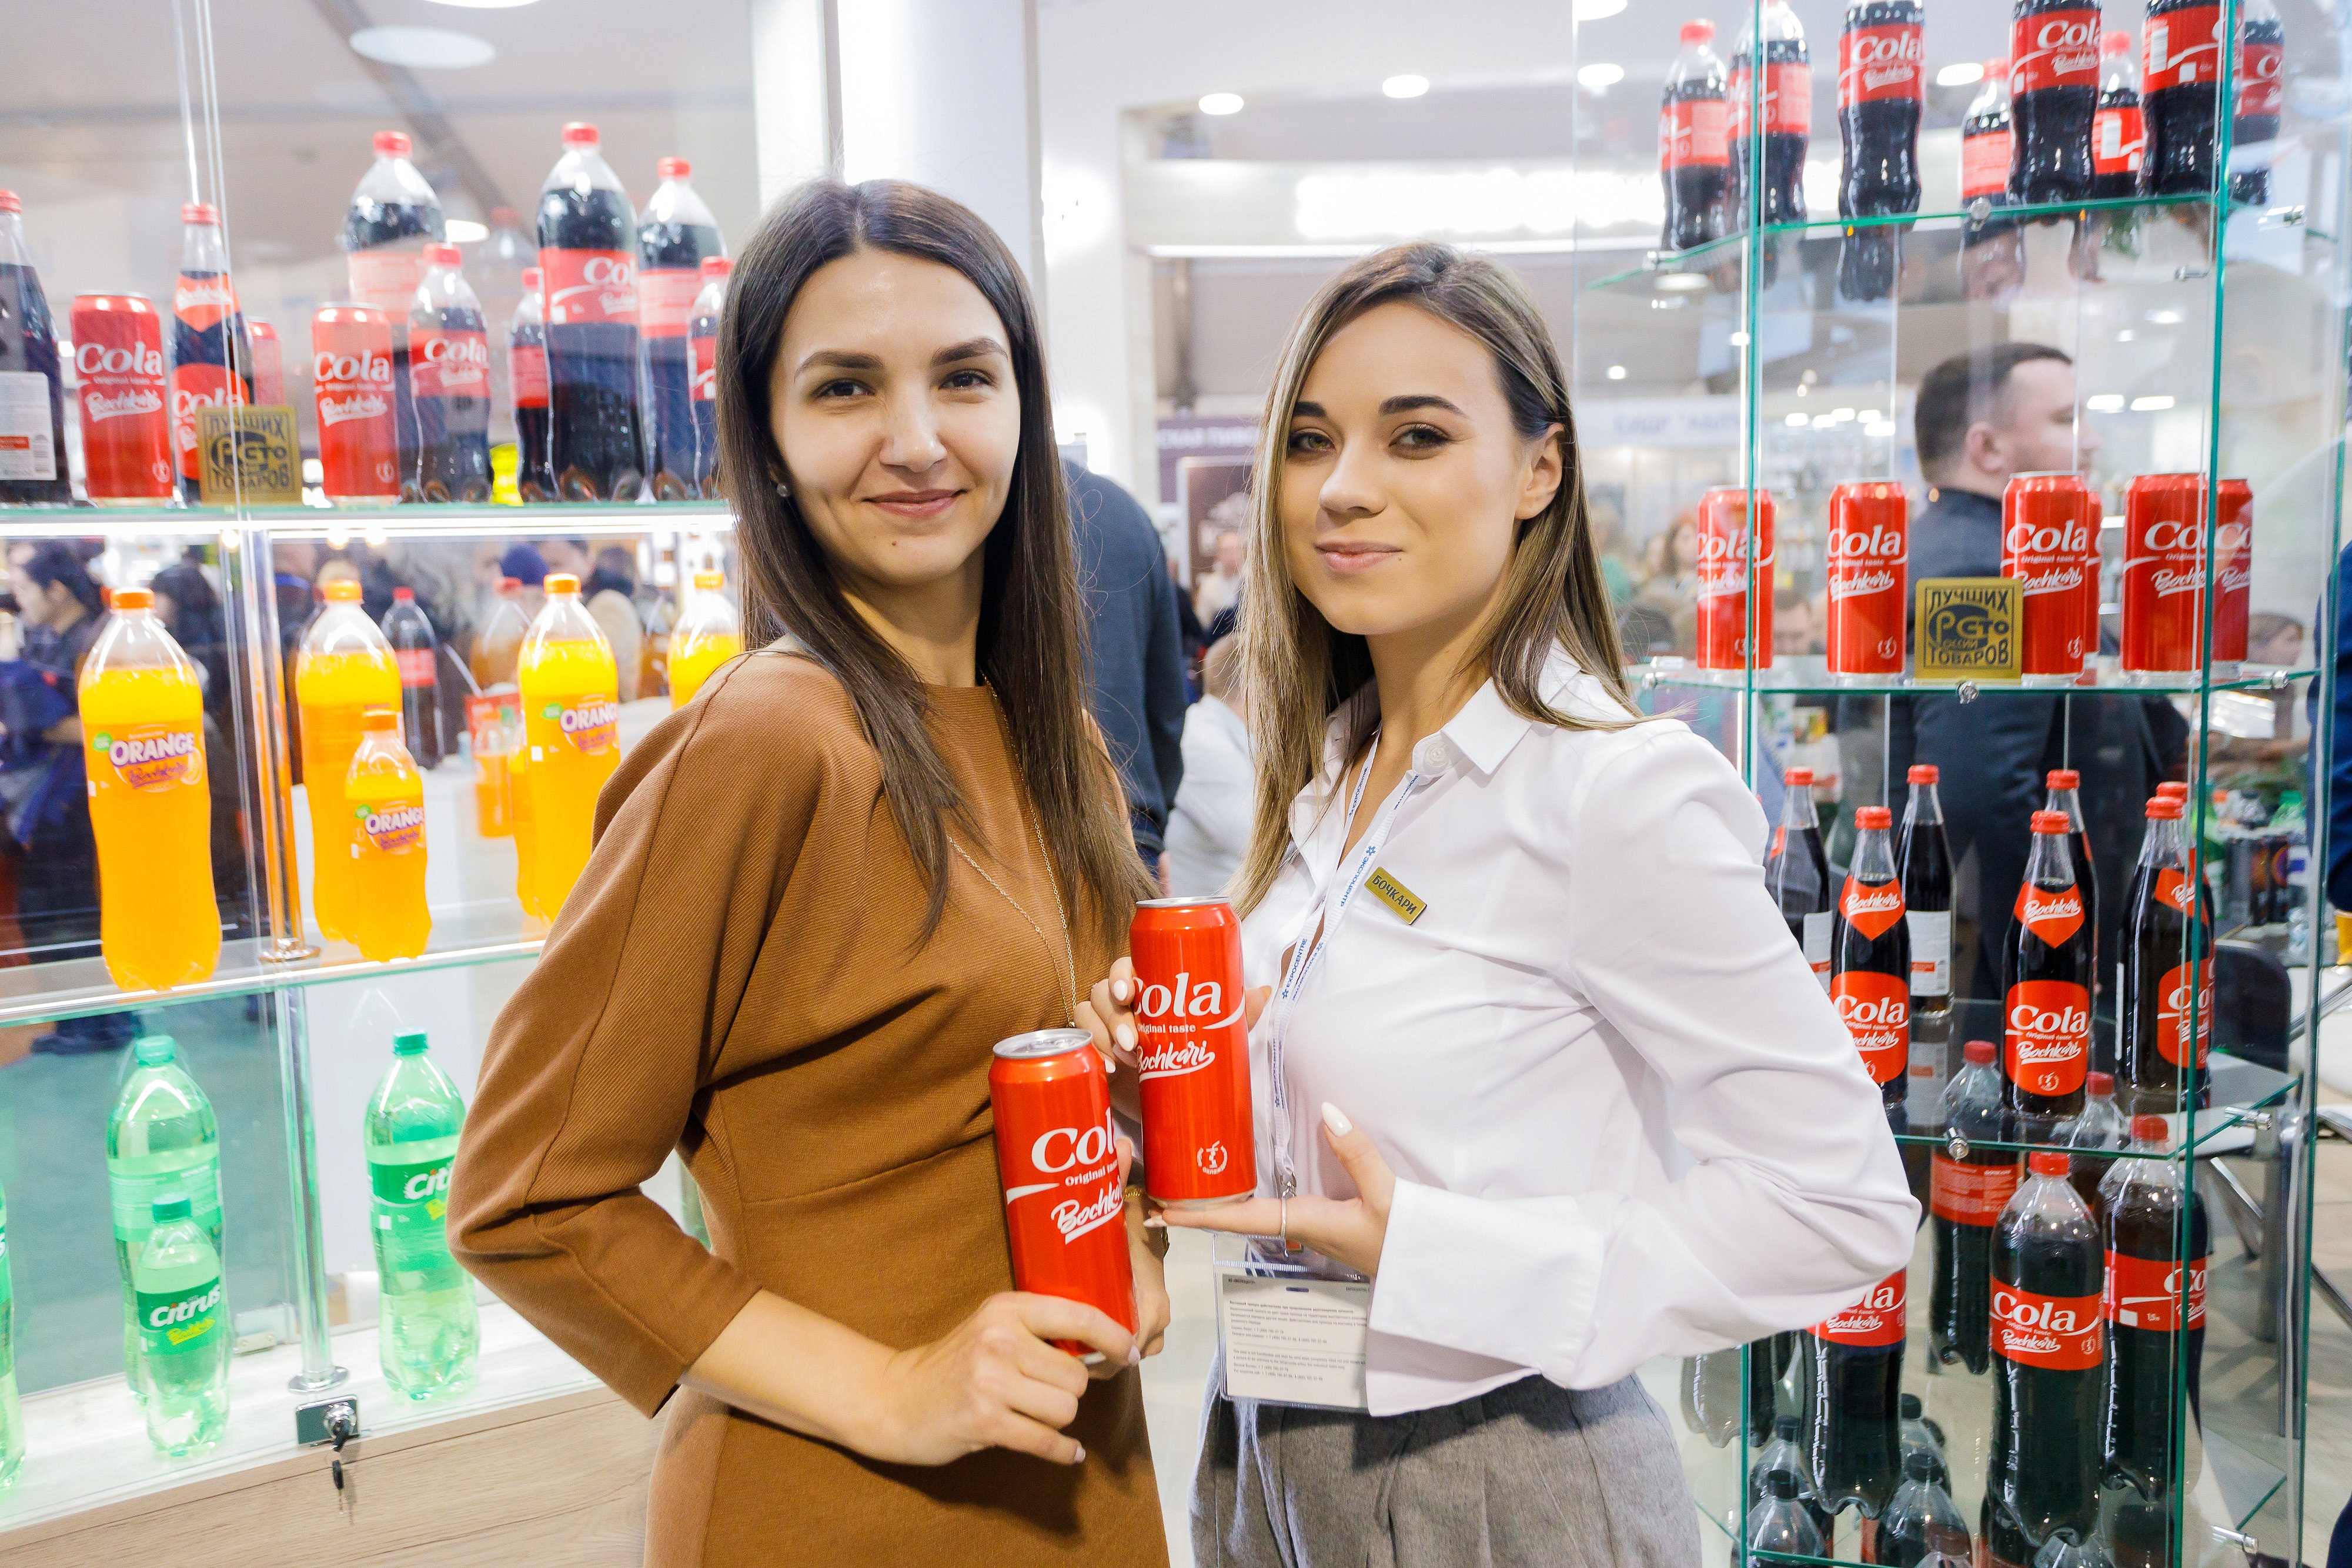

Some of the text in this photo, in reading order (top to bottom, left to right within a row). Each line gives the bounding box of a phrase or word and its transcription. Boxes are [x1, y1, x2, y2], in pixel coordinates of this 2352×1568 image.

[1851, 30, 1922, 64] Cola
[583, 256, 638, 287] Col
[77, 341, 163, 376] Cola
[314, 349, 390, 382] Cola
[425, 337, 486, 363] Cola
[1827, 524, 1901, 558] Cola
[2006, 519, 2087, 553] Cola
[2144, 518, 2208, 551] Col
[2214, 522, 2251, 550] Co
[1929, 589, 2008, 614] ЛУЧШИХ
[1929, 638, 2009, 665] ТОВАРОВ
[559, 702, 617, 734] ORANG
[109, 732, 194, 768] ORANGE
[1340, 856, 1369, 907] ЭКСПОЦЕНТР
[1372, 875, 1418, 915] БОЧКАРИ
[1286, 938, 1308, 988] EXPOCENTRE
[1833, 994, 1905, 1025] Cola
[2168, 985, 2210, 1011] Co
[1169, 1024, 1196, 1034] taste
[2010, 1004, 2087, 1033] Cola
[1853, 1030, 1899, 1052] ochkari
[1031, 1106, 1115, 1174] Col
[403, 1168, 452, 1201] Cit
[1065, 1159, 1118, 1186] Original tas
[1050, 1175, 1124, 1245] Bochka
[2164, 1268, 2206, 1294] Co
[1848, 1286, 1895, 1309] la
[1993, 1292, 2076, 1332] Cola
